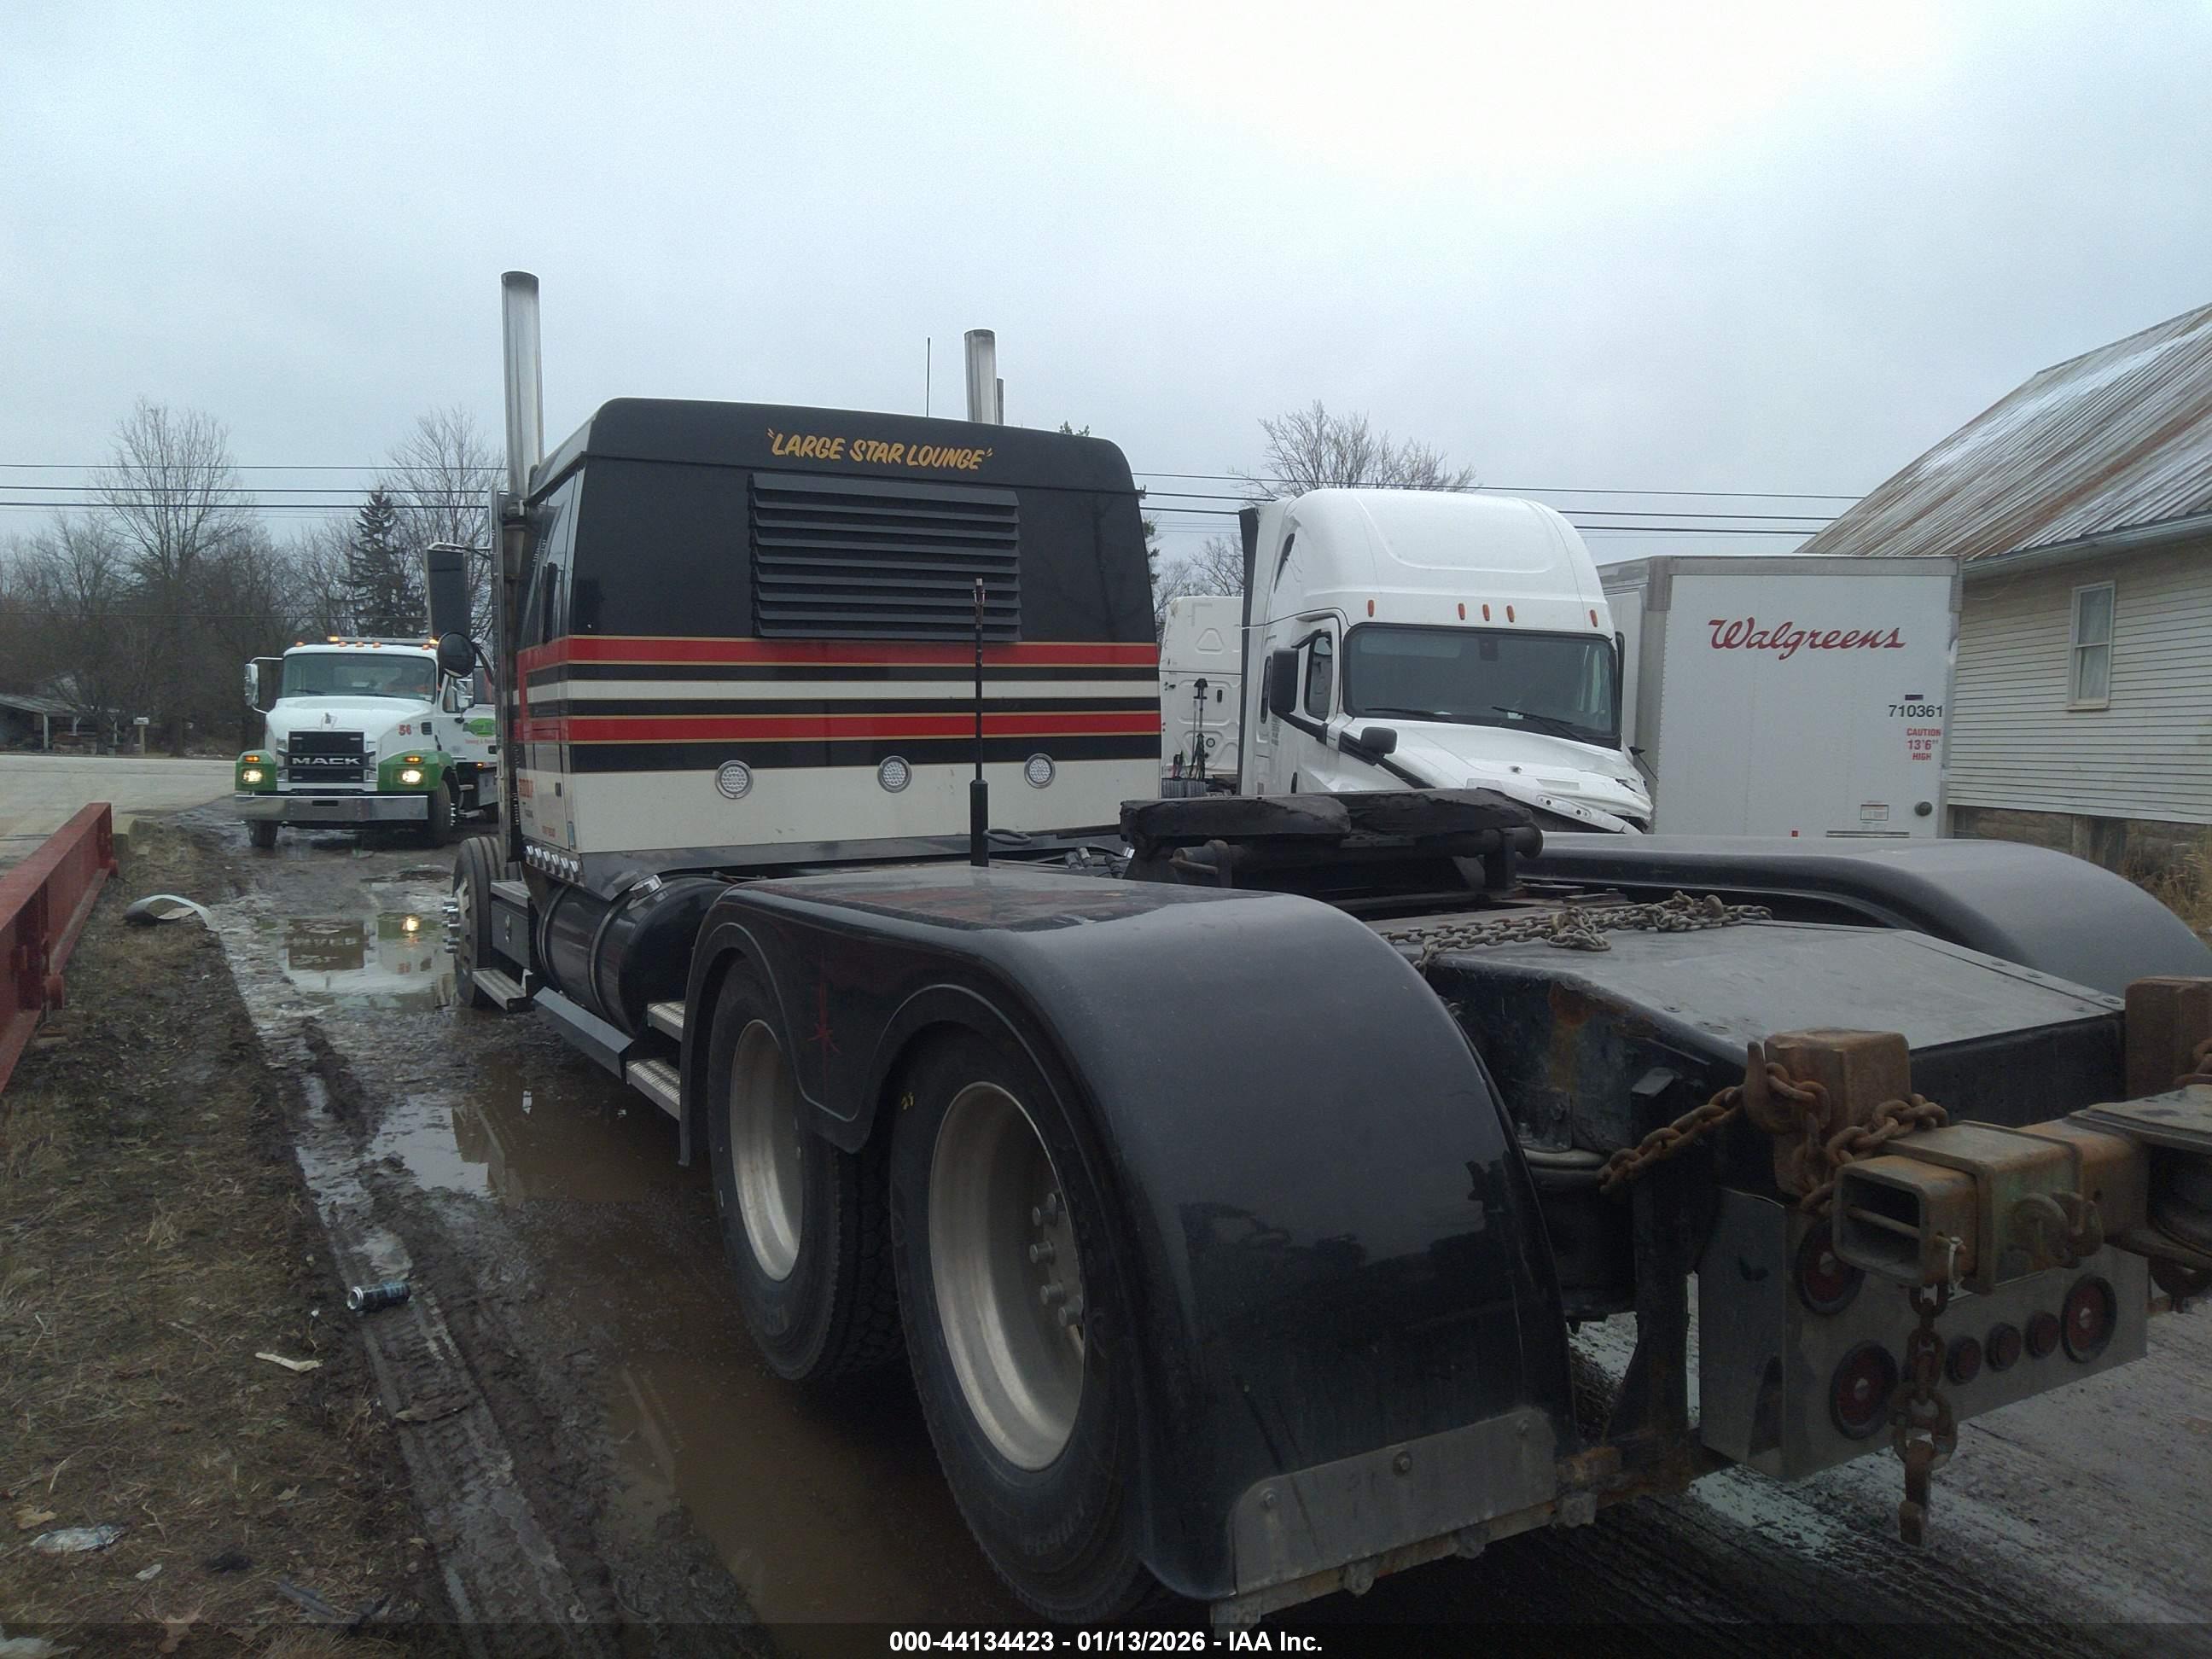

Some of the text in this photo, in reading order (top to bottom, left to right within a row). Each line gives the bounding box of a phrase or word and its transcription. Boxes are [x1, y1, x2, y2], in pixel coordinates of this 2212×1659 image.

[849, 438, 905, 465] STAR
[1708, 617, 1905, 660] Walgreens
[1888, 704, 1943, 718] 710361
[1906, 727, 1941, 736] CAUTION
[292, 756, 360, 765] MACK
[1912, 753, 1932, 761] HIGH
